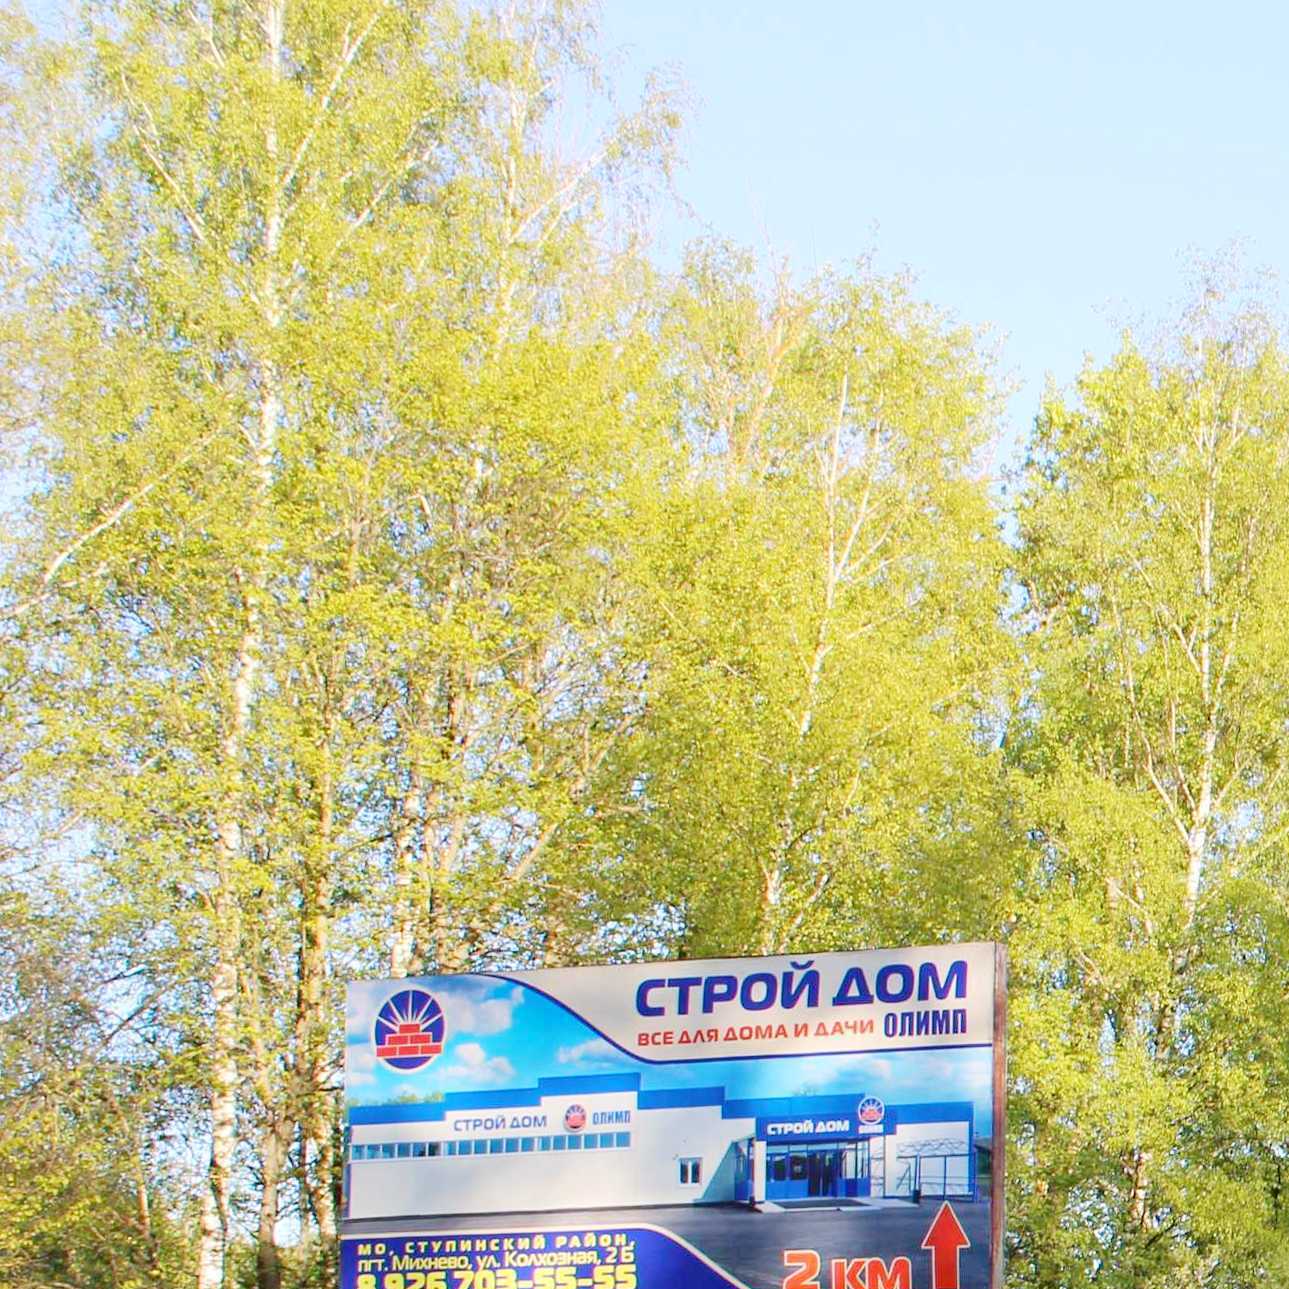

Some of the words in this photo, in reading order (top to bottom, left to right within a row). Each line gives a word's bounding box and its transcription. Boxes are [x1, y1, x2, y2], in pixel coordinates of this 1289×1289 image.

[636, 960, 820, 1017] СТРОЙ
[832, 960, 968, 1006] ДОМ
[637, 1031, 674, 1047] ВСЕ
[678, 1028, 719, 1044] ДЛЯ
[723, 1025, 788, 1042] ДОМА
[793, 1024, 809, 1037] И
[814, 1019, 875, 1037] ДАЧИ
[884, 1008, 968, 1038] ОЛИМП
[453, 1116, 507, 1132] СТРОЙ
[510, 1115, 548, 1129] ДОМ
[592, 1110, 631, 1126] ОЛИМП
[766, 1119, 814, 1136] СТРОЙ
[815, 1120, 850, 1133] ДОМ
[357, 1243, 394, 1256] МО,
[405, 1235, 546, 1253] СТУПИНСКИЙ
[555, 1232, 635, 1248] РАЙОН,
[358, 1259, 389, 1272] пгт.
[392, 1254, 473, 1271] Михнево,
[476, 1253, 501, 1271] ул.
[504, 1250, 602, 1267] Колхозная,
[605, 1247, 618, 1263] 2
